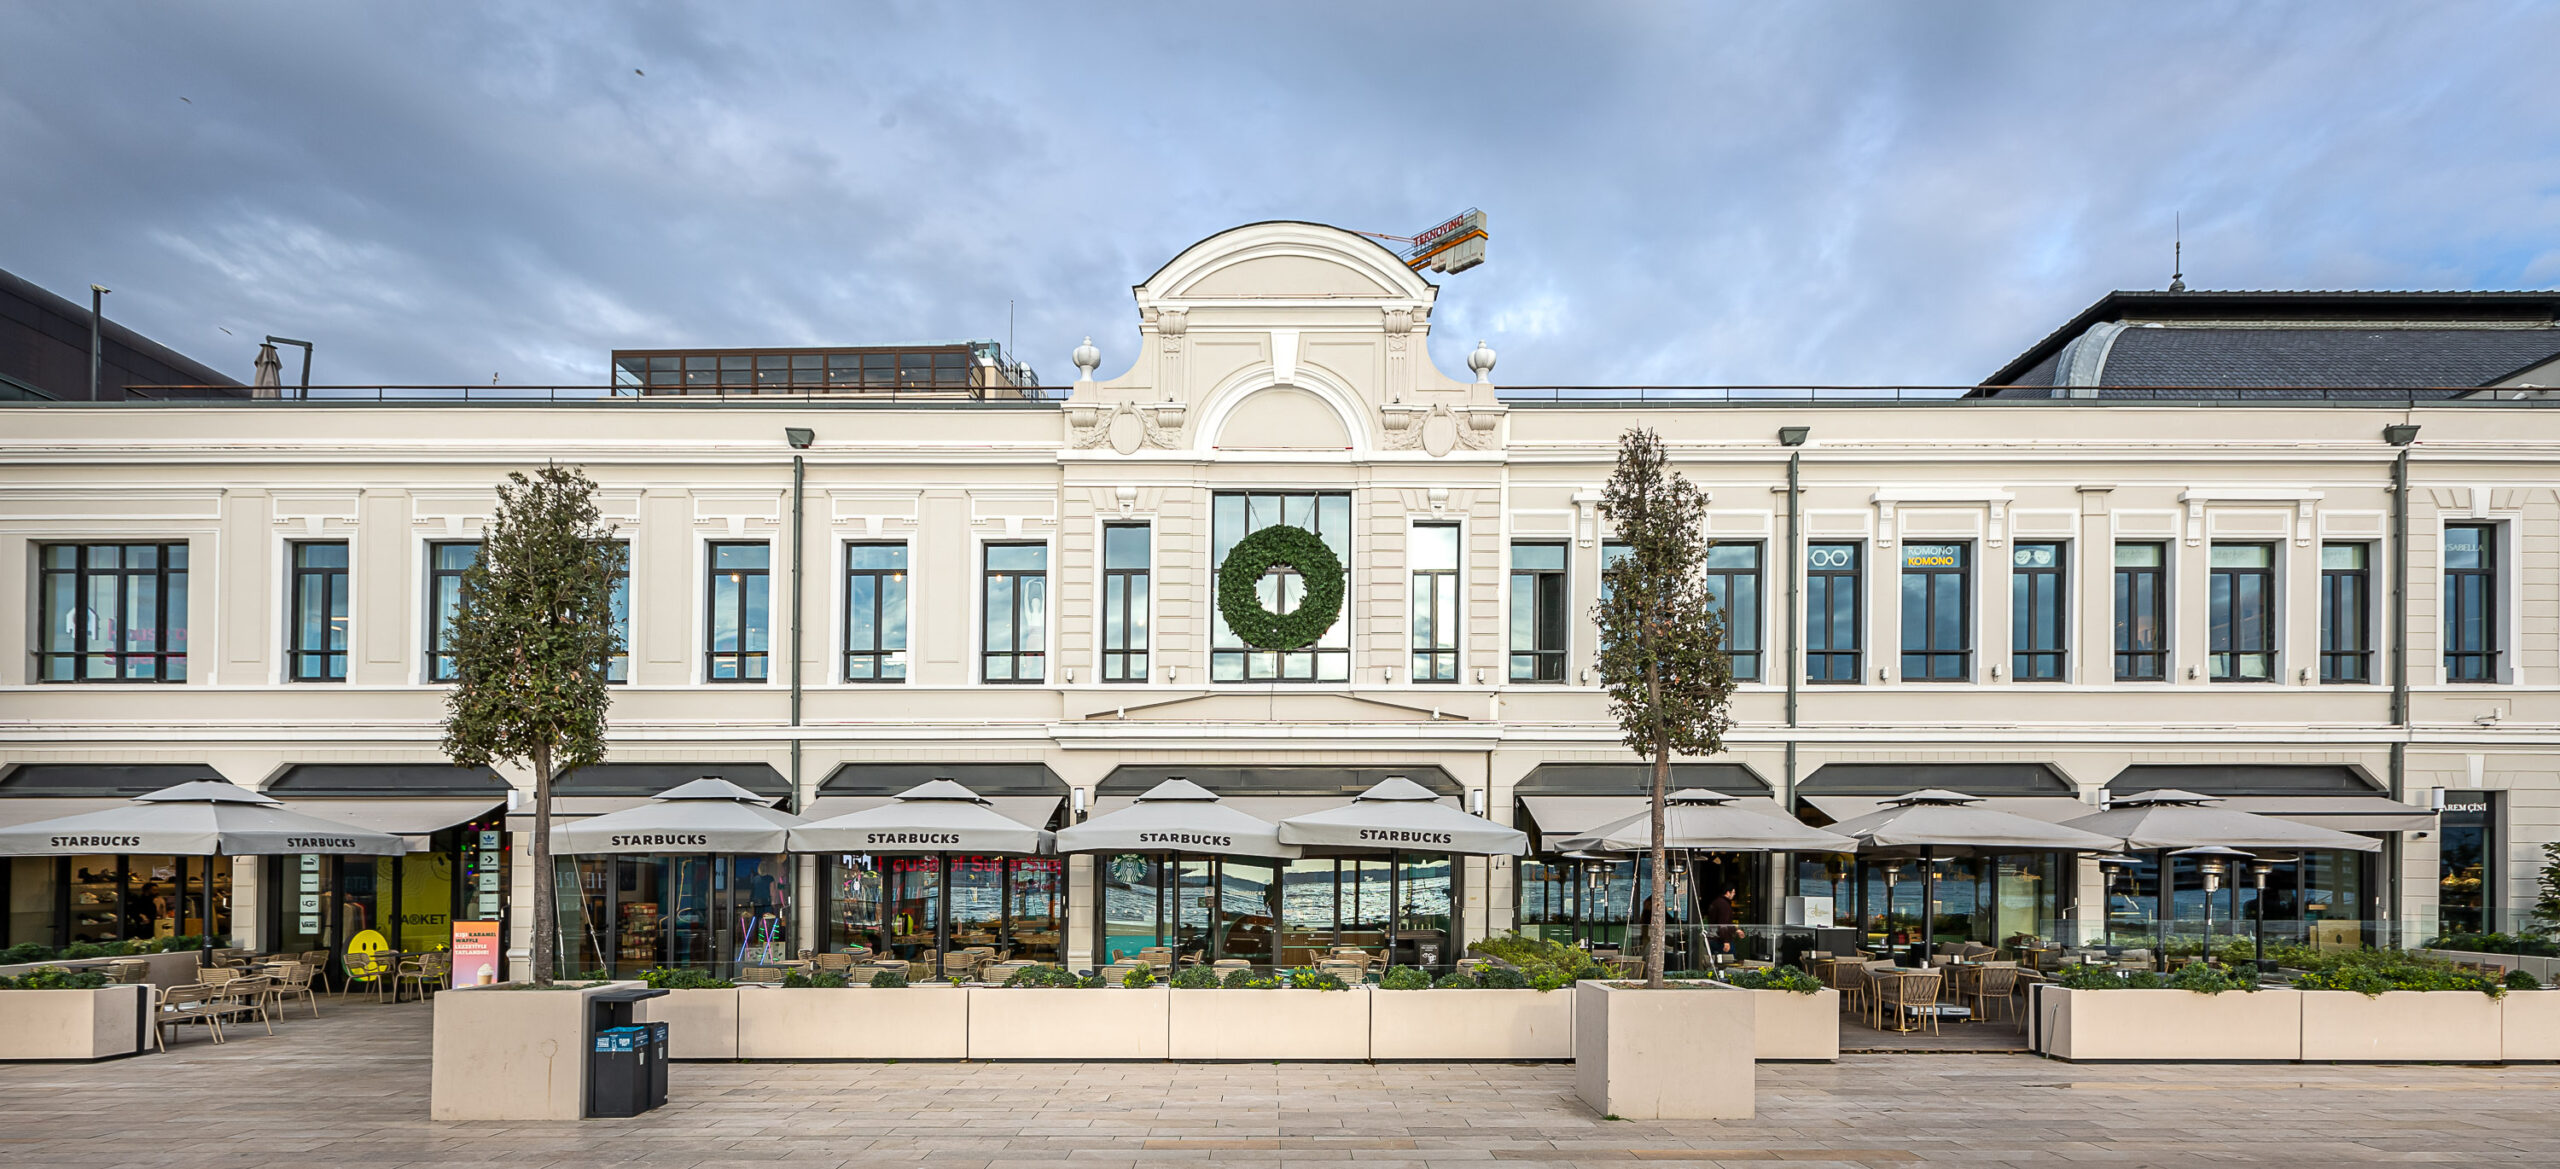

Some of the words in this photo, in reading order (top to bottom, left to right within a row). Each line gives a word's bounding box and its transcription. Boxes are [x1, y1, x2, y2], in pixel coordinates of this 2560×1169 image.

[1413, 214, 1464, 247] TEKNOVING
[1907, 546, 1954, 555] KOMONO
[1907, 556, 1954, 566] KOMONO
[51, 836, 140, 847] STARBUCKS
[286, 837, 357, 848] STARBUCKS
[611, 834, 708, 846] STARBUCKS
[867, 833, 960, 845] STARBUCKS
[1139, 832, 1232, 847] STARBUCKS
[1359, 829, 1452, 844] STARBUCKS
